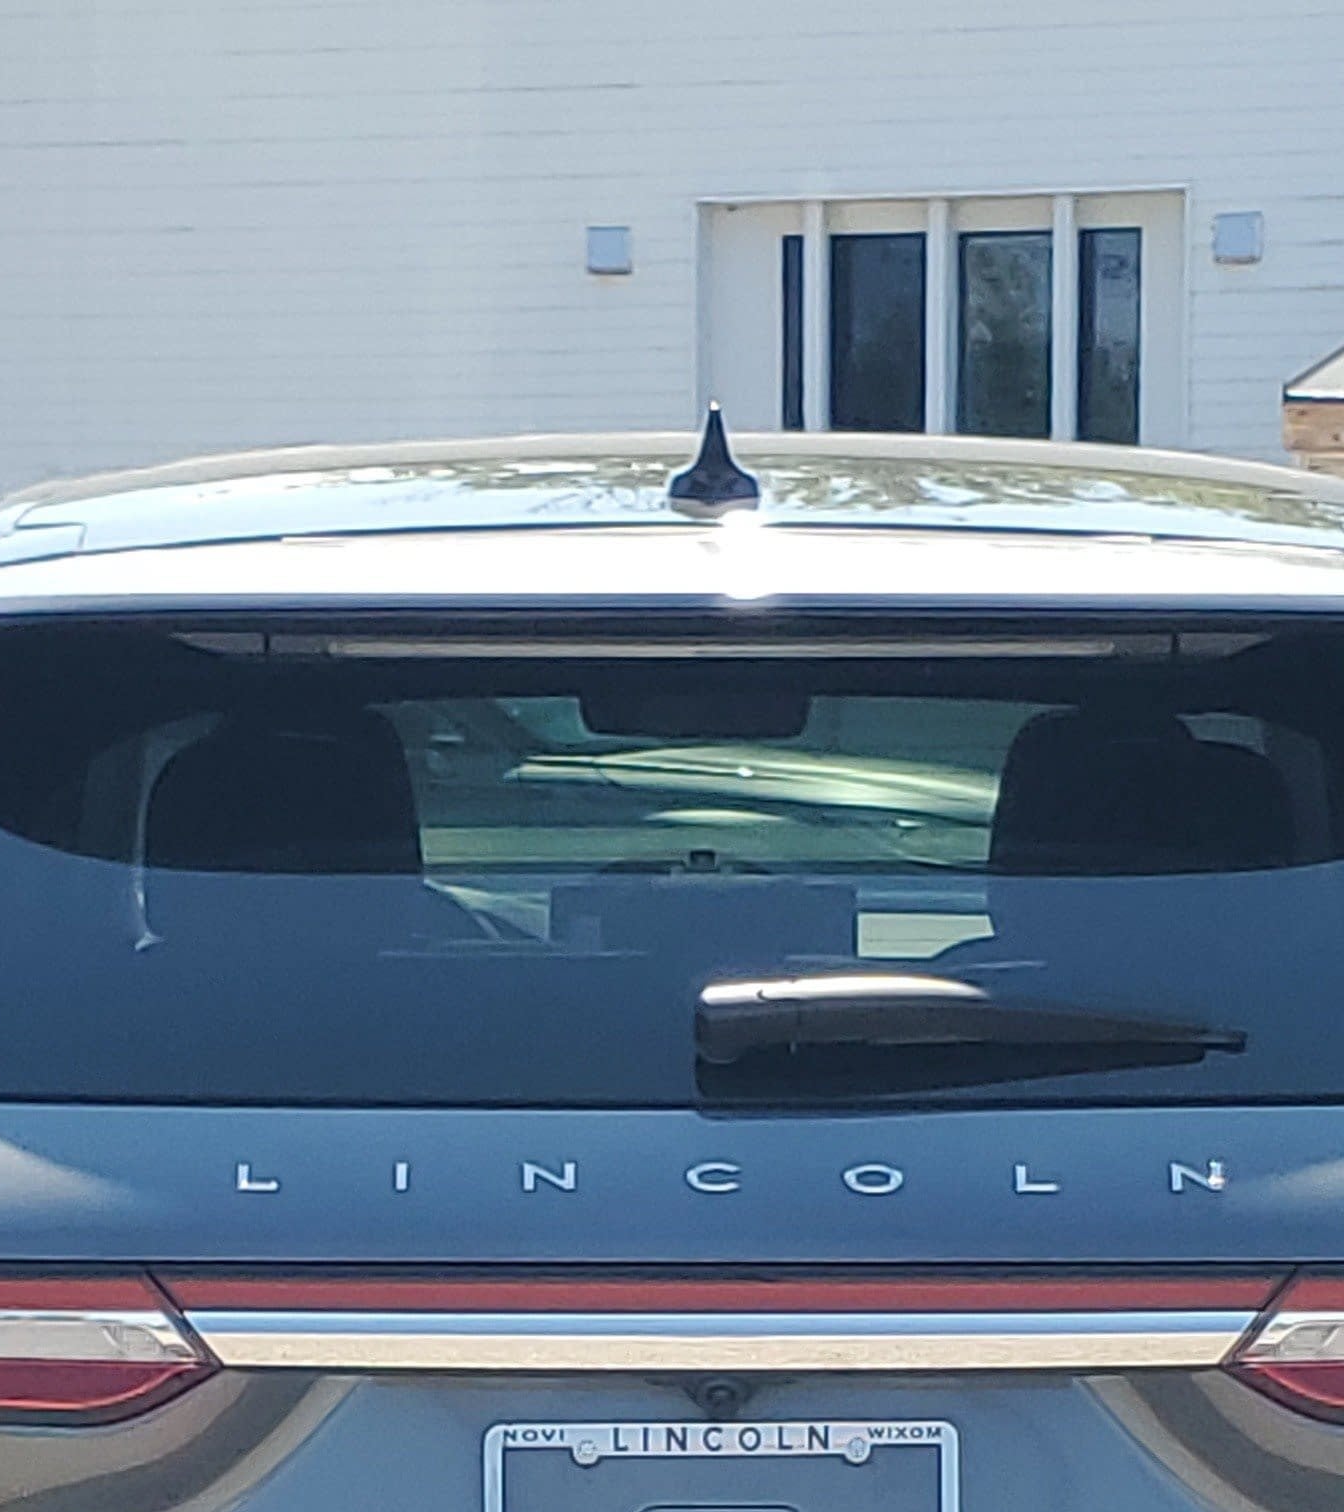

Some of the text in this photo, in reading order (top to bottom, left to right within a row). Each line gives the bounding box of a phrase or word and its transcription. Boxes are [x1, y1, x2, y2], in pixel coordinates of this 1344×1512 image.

[236, 1160, 1227, 1193] LINCOLN
[503, 1428, 565, 1442] NOVI
[612, 1425, 830, 1452] LINCOLN
[867, 1426, 942, 1440] WIXOM
